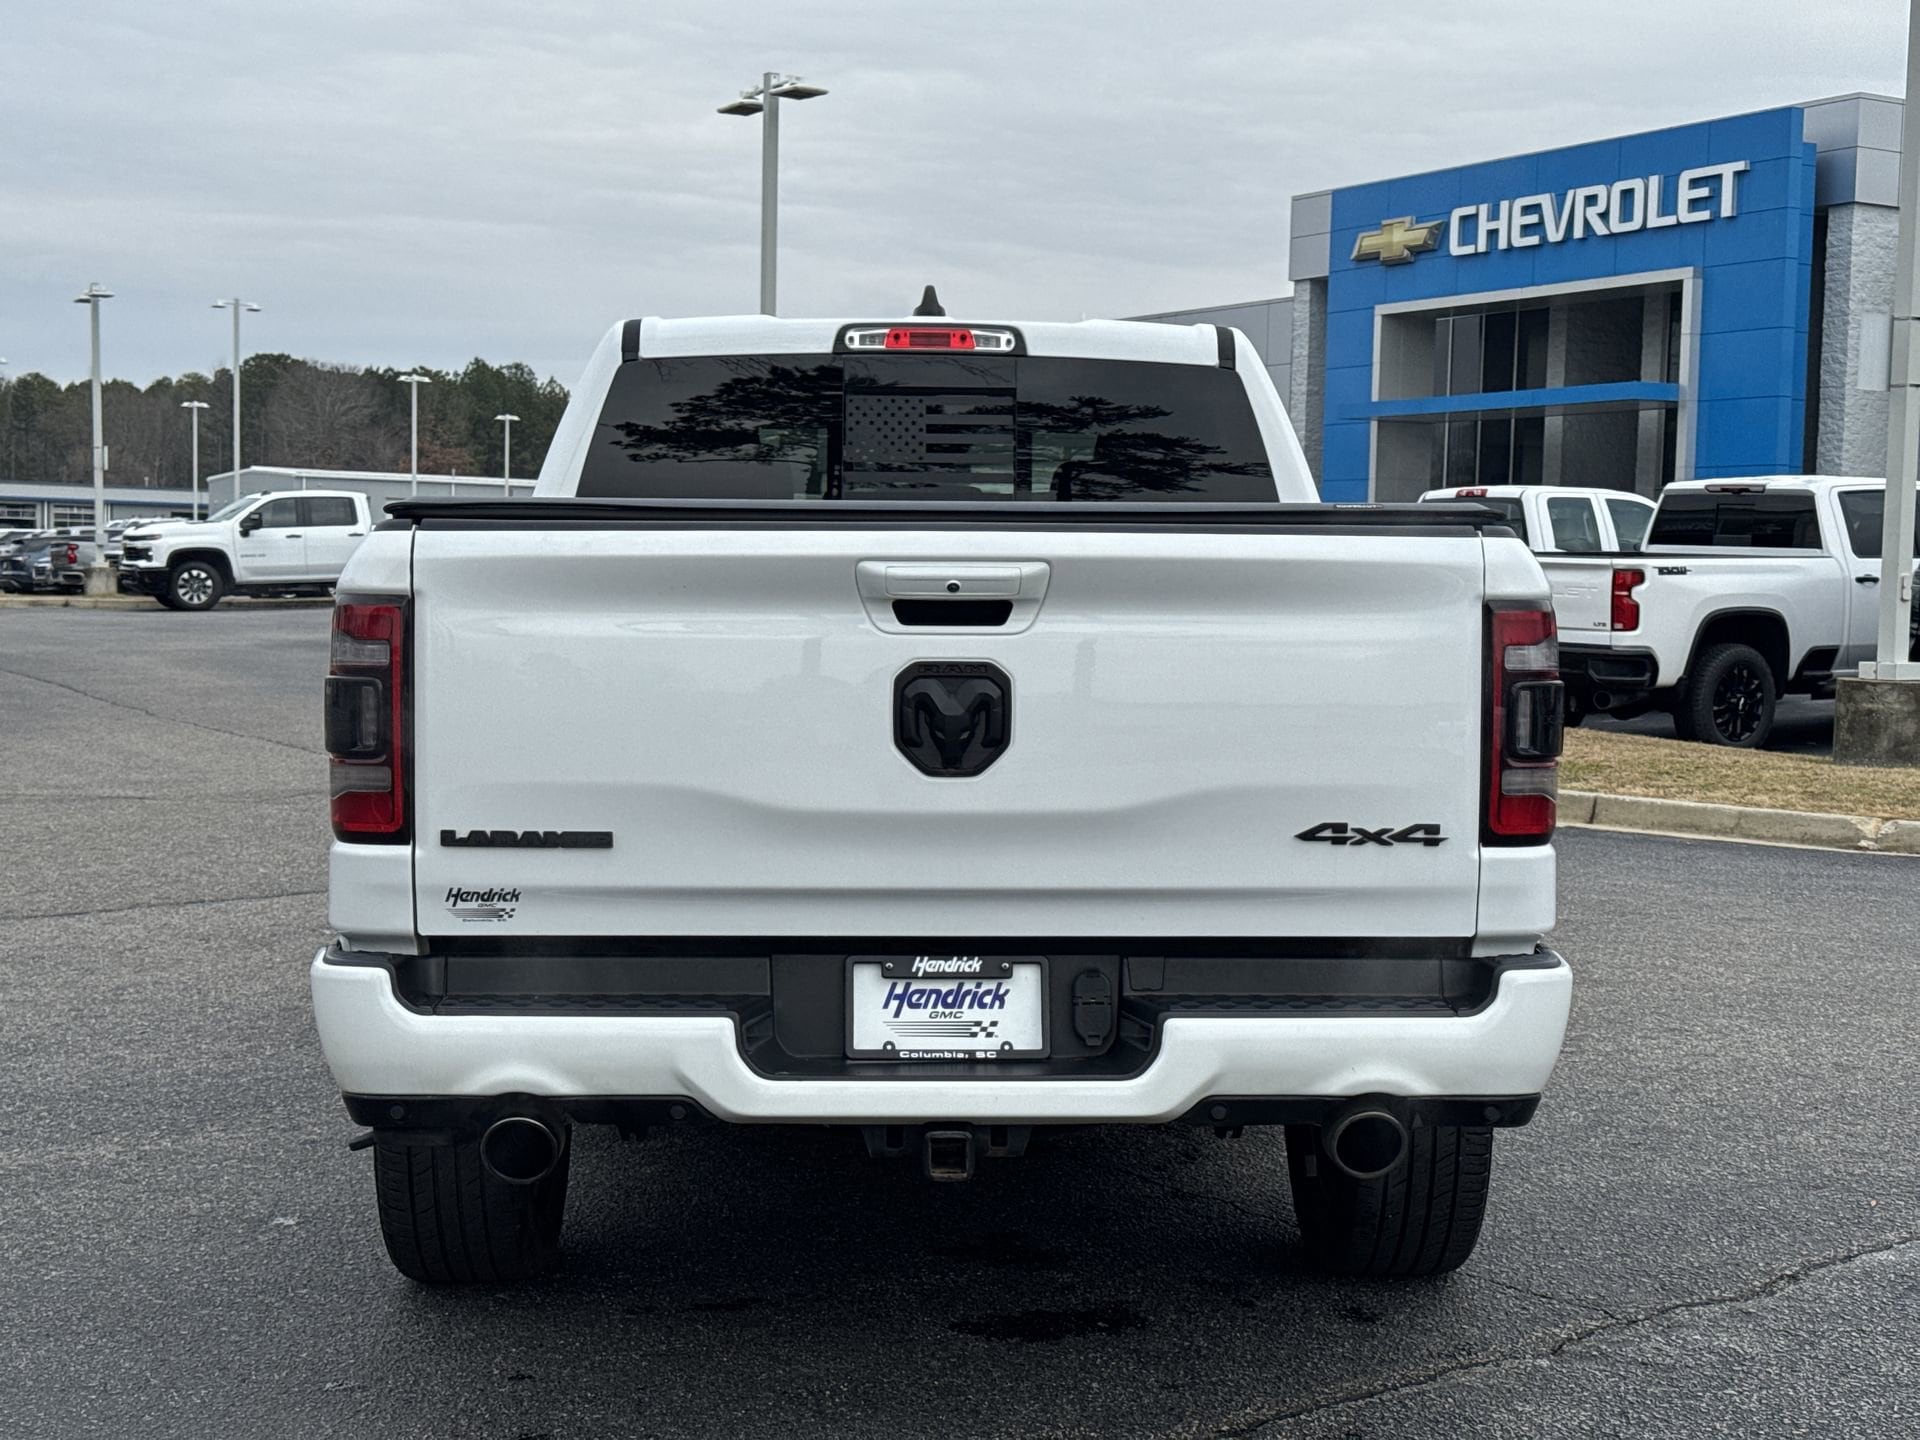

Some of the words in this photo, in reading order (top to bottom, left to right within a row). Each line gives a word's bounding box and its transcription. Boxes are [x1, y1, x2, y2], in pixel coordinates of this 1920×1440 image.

[1449, 159, 1750, 257] CHEVROLET
[918, 664, 988, 674] RAM
[1294, 822, 1449, 847] 4x4
[445, 887, 522, 908] Hendrick
[911, 956, 983, 977] Hendrick
[882, 981, 1010, 1019] Hendrick
[928, 1011, 965, 1019] GMC
[899, 1050, 969, 1059] Columbia,
[975, 1050, 998, 1059] SC
